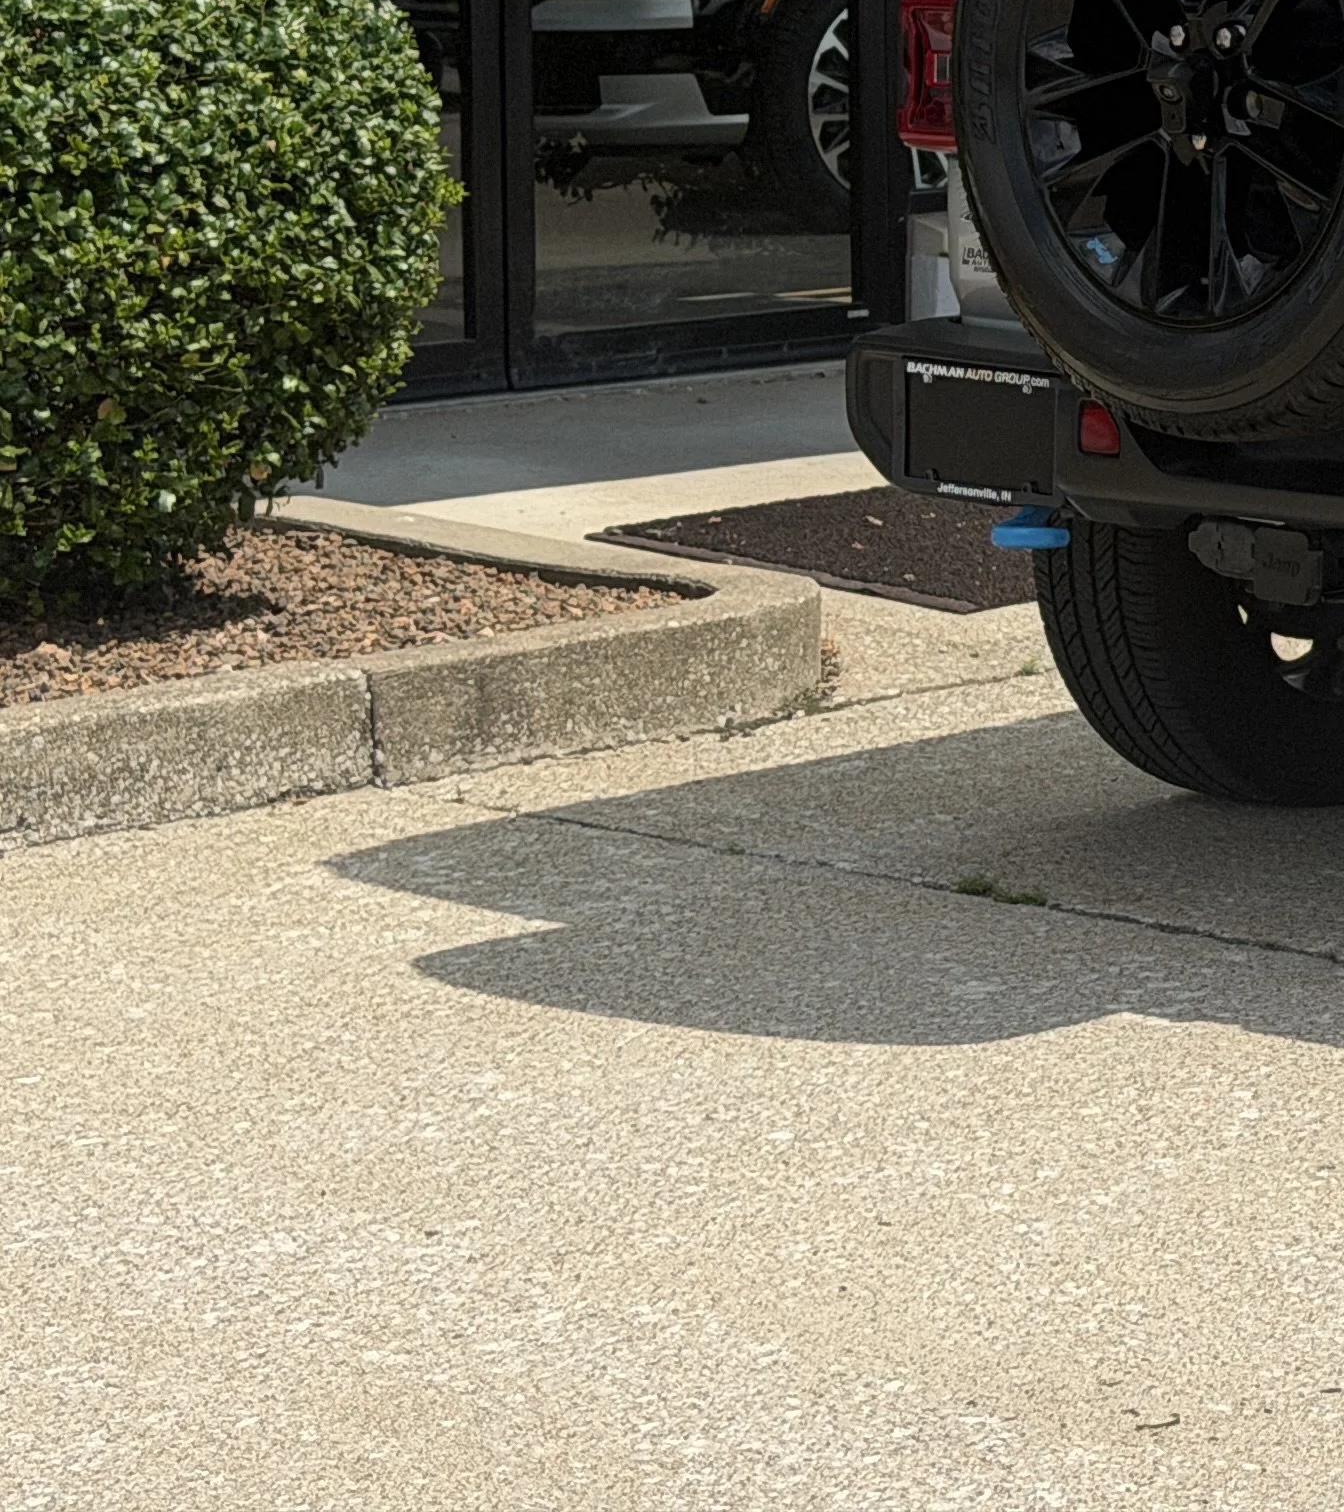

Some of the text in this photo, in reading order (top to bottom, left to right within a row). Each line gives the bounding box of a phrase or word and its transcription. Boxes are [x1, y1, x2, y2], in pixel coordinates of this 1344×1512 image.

[906, 361, 965, 379] BACHMAN
[965, 367, 993, 382] AUTO
[937, 482, 1012, 502] Jeffersonville, IN
